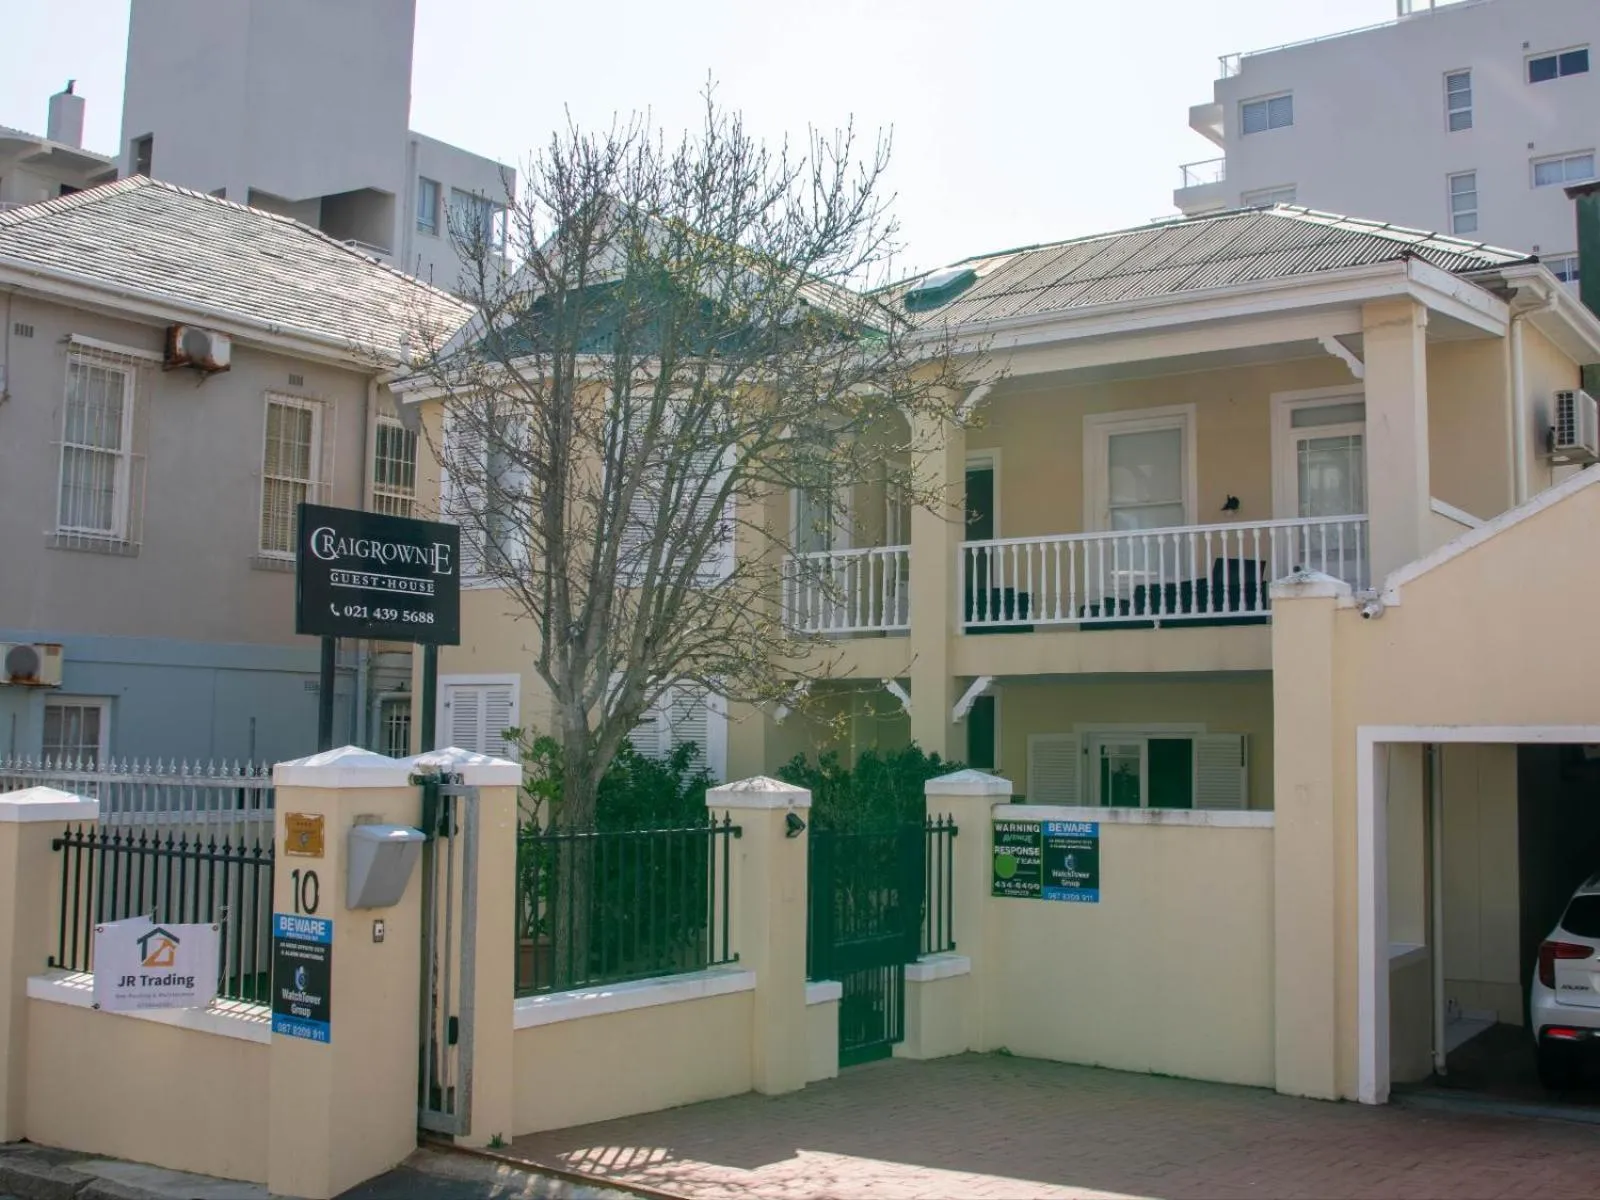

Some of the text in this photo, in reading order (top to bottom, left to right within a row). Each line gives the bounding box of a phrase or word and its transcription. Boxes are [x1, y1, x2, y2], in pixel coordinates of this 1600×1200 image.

[310, 526, 453, 575] CRAIGROWNIE
[330, 572, 435, 593] GUEST HOUSE
[344, 605, 435, 624] 021 439 5688
[995, 823, 1040, 832] WARNING
[1048, 822, 1092, 833] BEWARE
[994, 846, 1040, 856] RESPONSE
[291, 868, 320, 915] 10
[280, 915, 325, 936] BEWARE
[118, 973, 195, 988] JR Trading
[282, 988, 322, 1005] WatchTower
[291, 1003, 312, 1018] Group
[312, 1028, 325, 1040] 911
